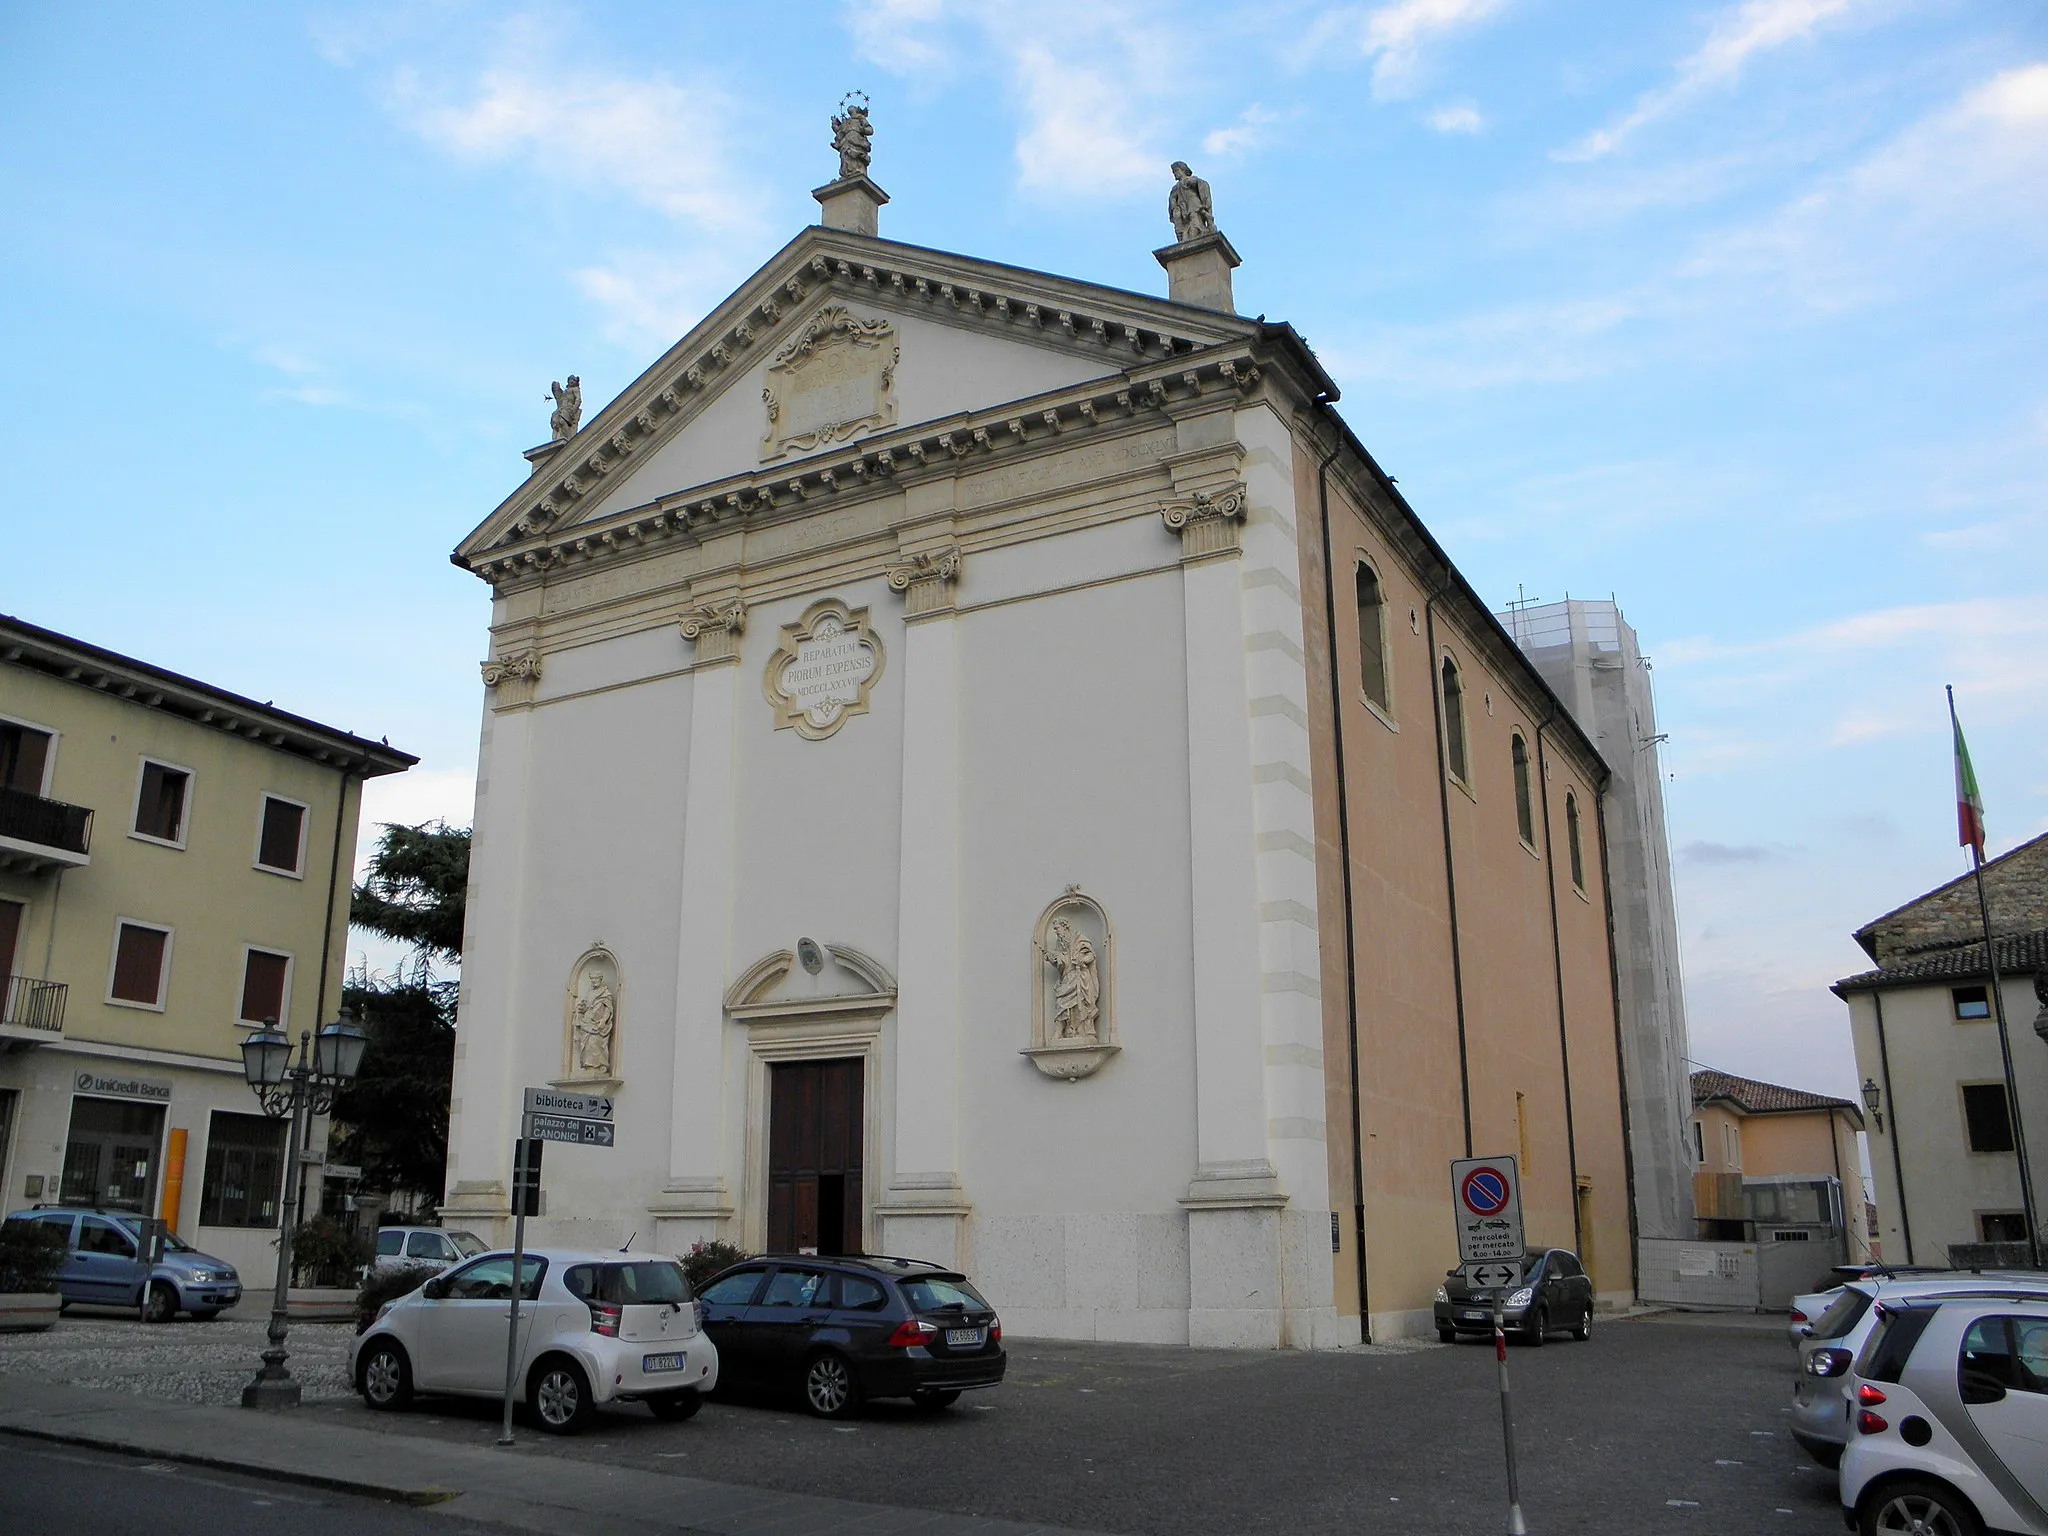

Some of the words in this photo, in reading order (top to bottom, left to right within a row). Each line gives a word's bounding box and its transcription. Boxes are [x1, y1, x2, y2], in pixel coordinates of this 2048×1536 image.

[803, 643, 855, 662] REPARATUM
[788, 666, 822, 683] PIORUM
[826, 656, 871, 676] EXPENSIS
[95, 1078, 139, 1094] UniCredit
[141, 1083, 169, 1097] Banca
[536, 1094, 583, 1110] biblioteca
[534, 1117, 565, 1128] palazzo
[533, 1128, 579, 1141] CANONICI
[1482, 1240, 1515, 1249] mercato
